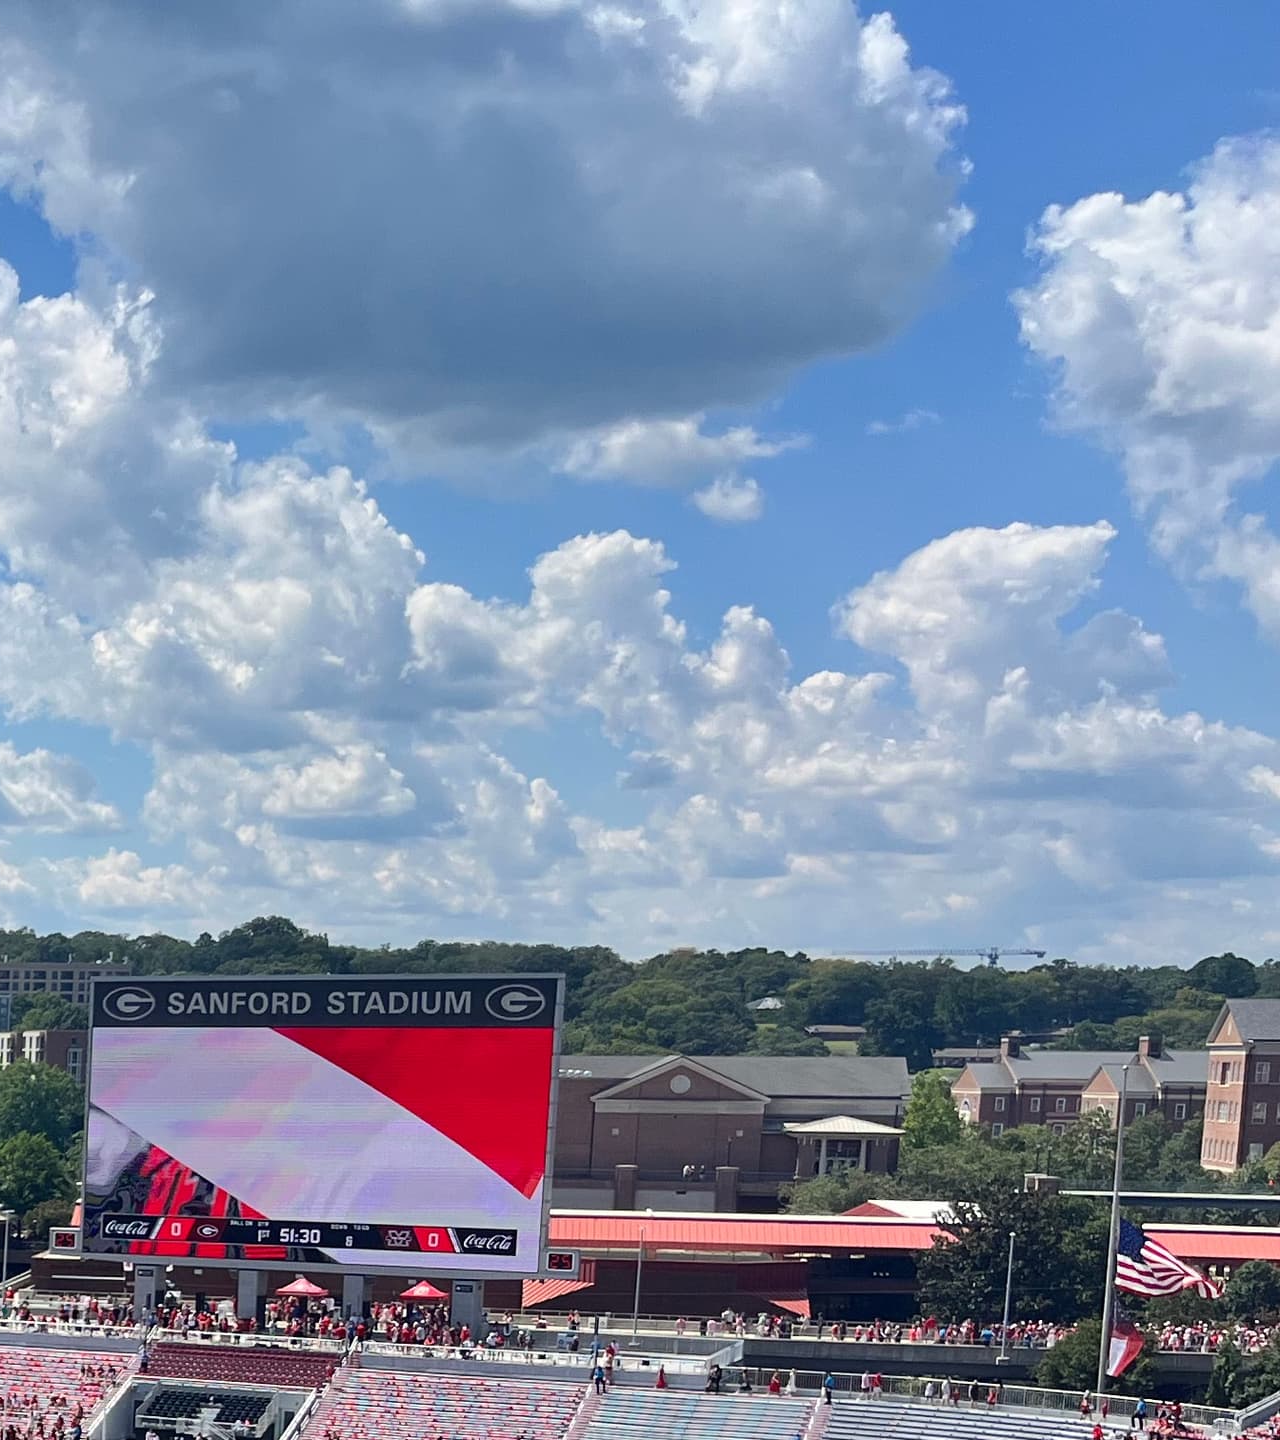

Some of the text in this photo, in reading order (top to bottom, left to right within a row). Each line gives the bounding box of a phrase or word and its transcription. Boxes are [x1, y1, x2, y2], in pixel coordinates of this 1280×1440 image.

[167, 990, 472, 1015] SANFORD STADIUM
[170, 1222, 181, 1236] 0
[279, 1227, 320, 1244] 51:30
[56, 1233, 73, 1247] 25
[427, 1232, 439, 1247] 0
[549, 1254, 571, 1269] 25
